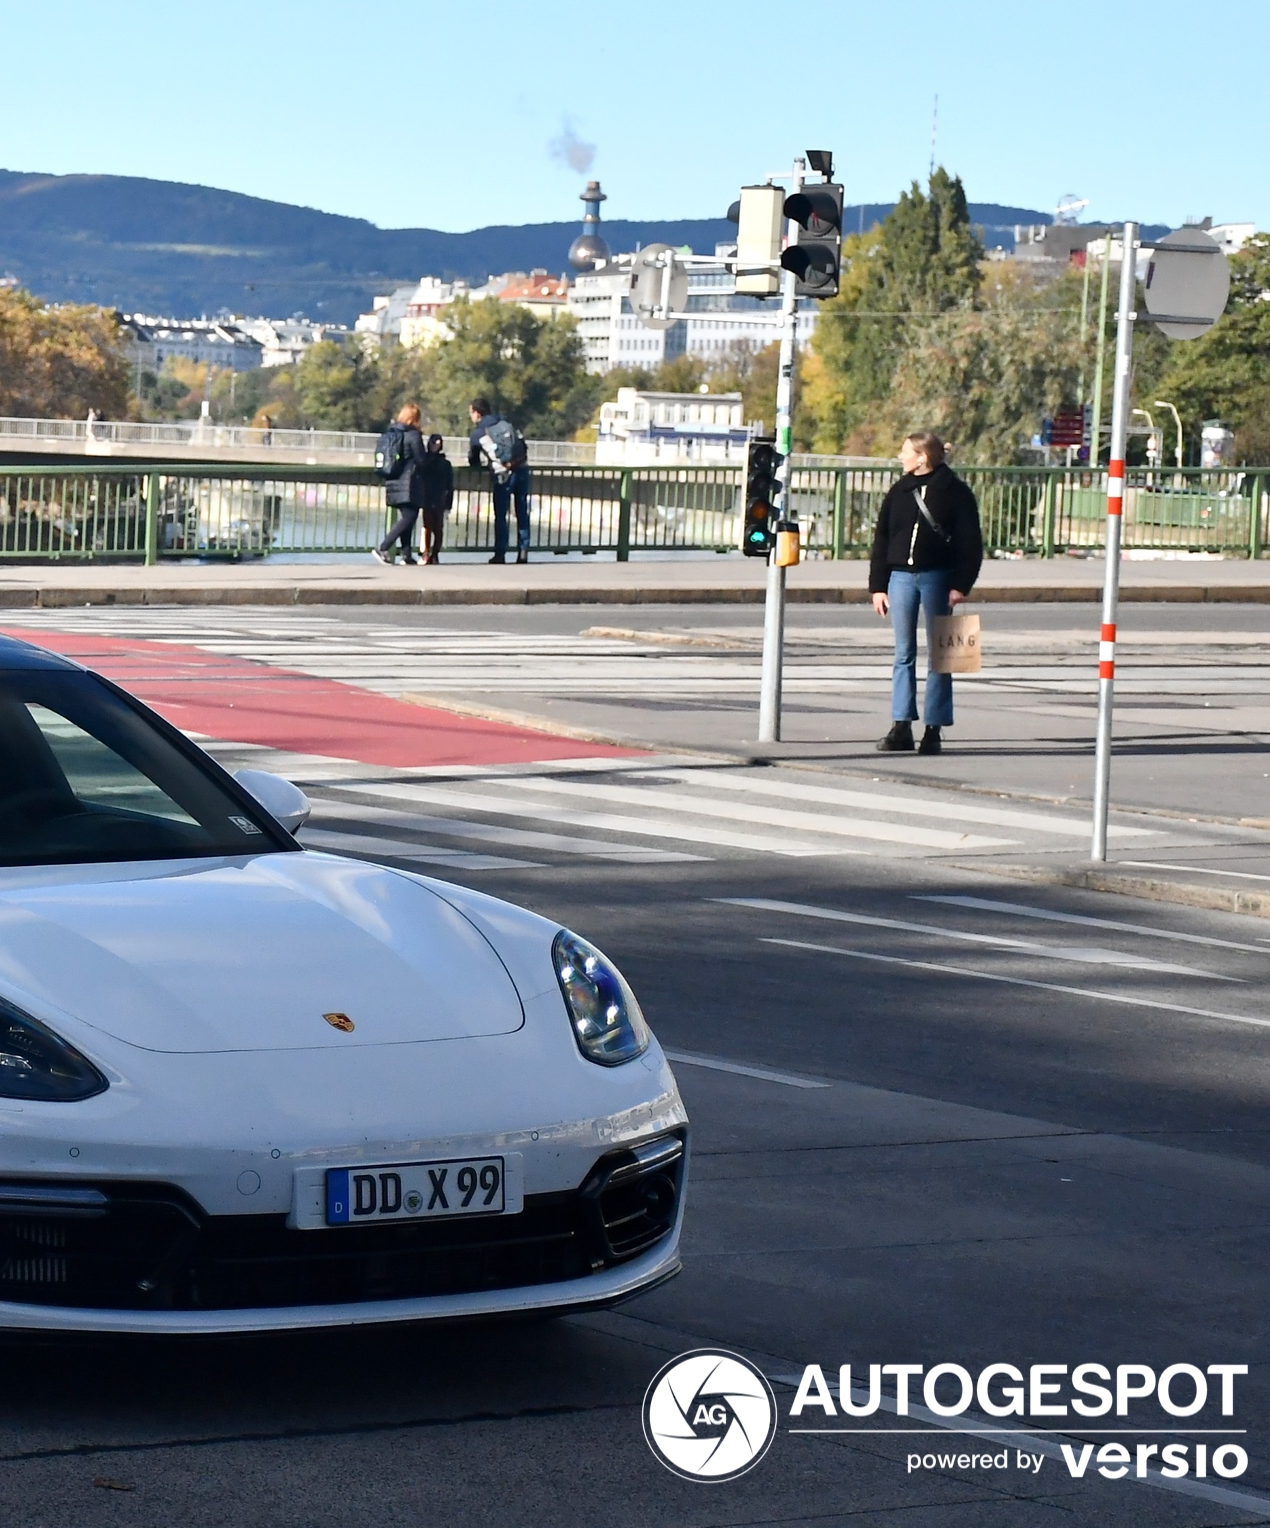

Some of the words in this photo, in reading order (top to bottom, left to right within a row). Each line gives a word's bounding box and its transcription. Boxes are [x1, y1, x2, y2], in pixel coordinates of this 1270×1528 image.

[939, 635, 976, 648] LANG
[334, 1201, 343, 1214] D
[353, 1173, 402, 1216] DD
[427, 1168, 449, 1210] X
[457, 1164, 500, 1208] 99
